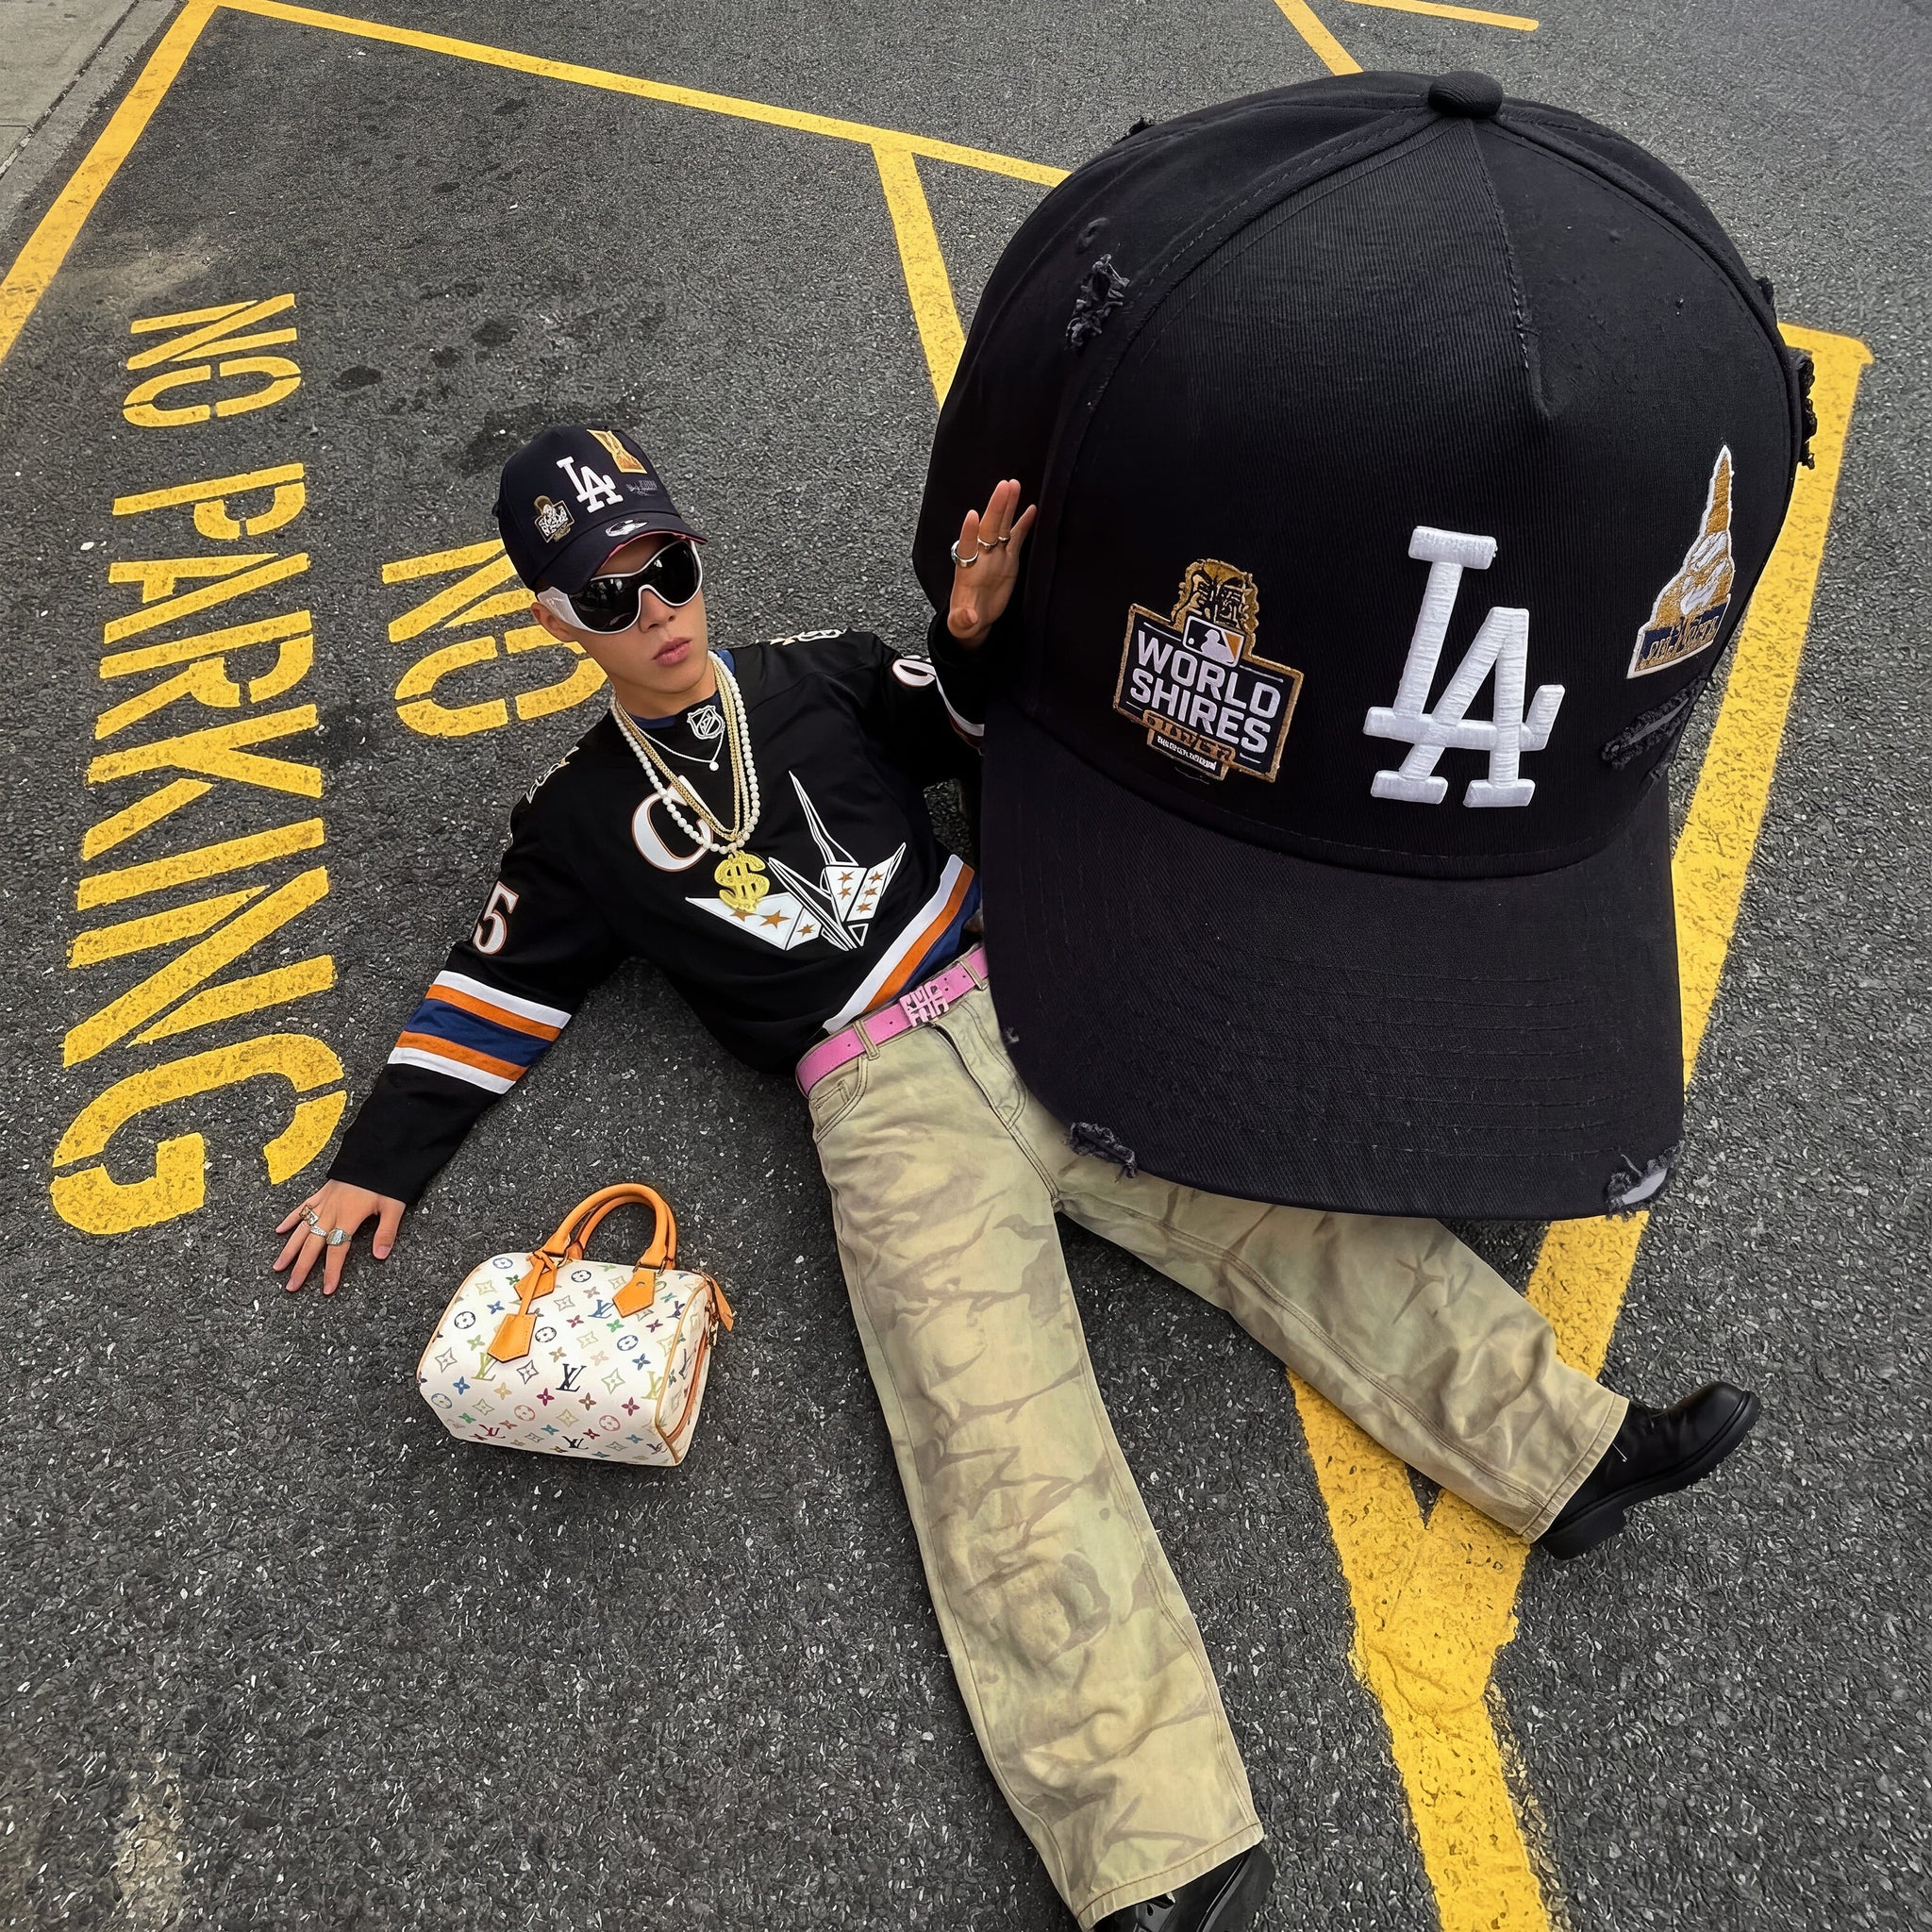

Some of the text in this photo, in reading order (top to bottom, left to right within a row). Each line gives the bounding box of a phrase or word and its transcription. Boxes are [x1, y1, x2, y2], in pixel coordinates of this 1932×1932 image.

[556, 456, 624, 514] LA
[381, 540, 608, 737] NO
[1137, 629, 1281, 720] WORLD
[1363, 525, 1565, 808] LA
[1129, 668, 1272, 754] SHIRES
[50, 292, 347, 1235] NO PARKING
[473, 880, 519, 956] 5
